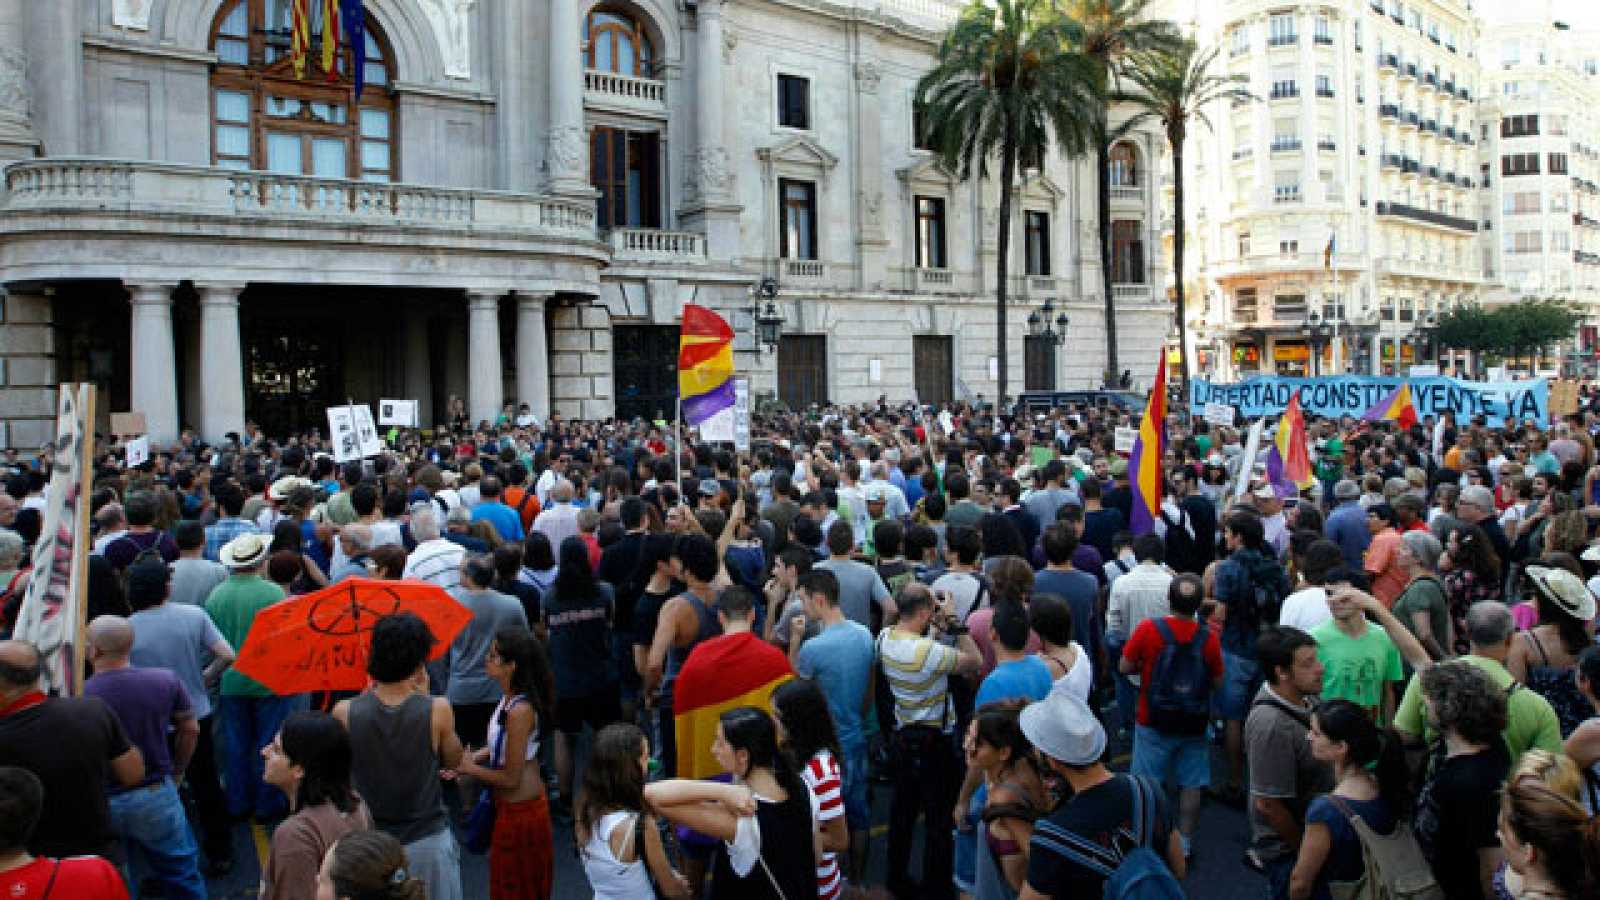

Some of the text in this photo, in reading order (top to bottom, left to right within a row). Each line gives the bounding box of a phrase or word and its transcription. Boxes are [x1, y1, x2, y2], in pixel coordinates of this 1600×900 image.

[1194, 382, 1542, 418] LIBERTAD CONSTITYENTE YA
